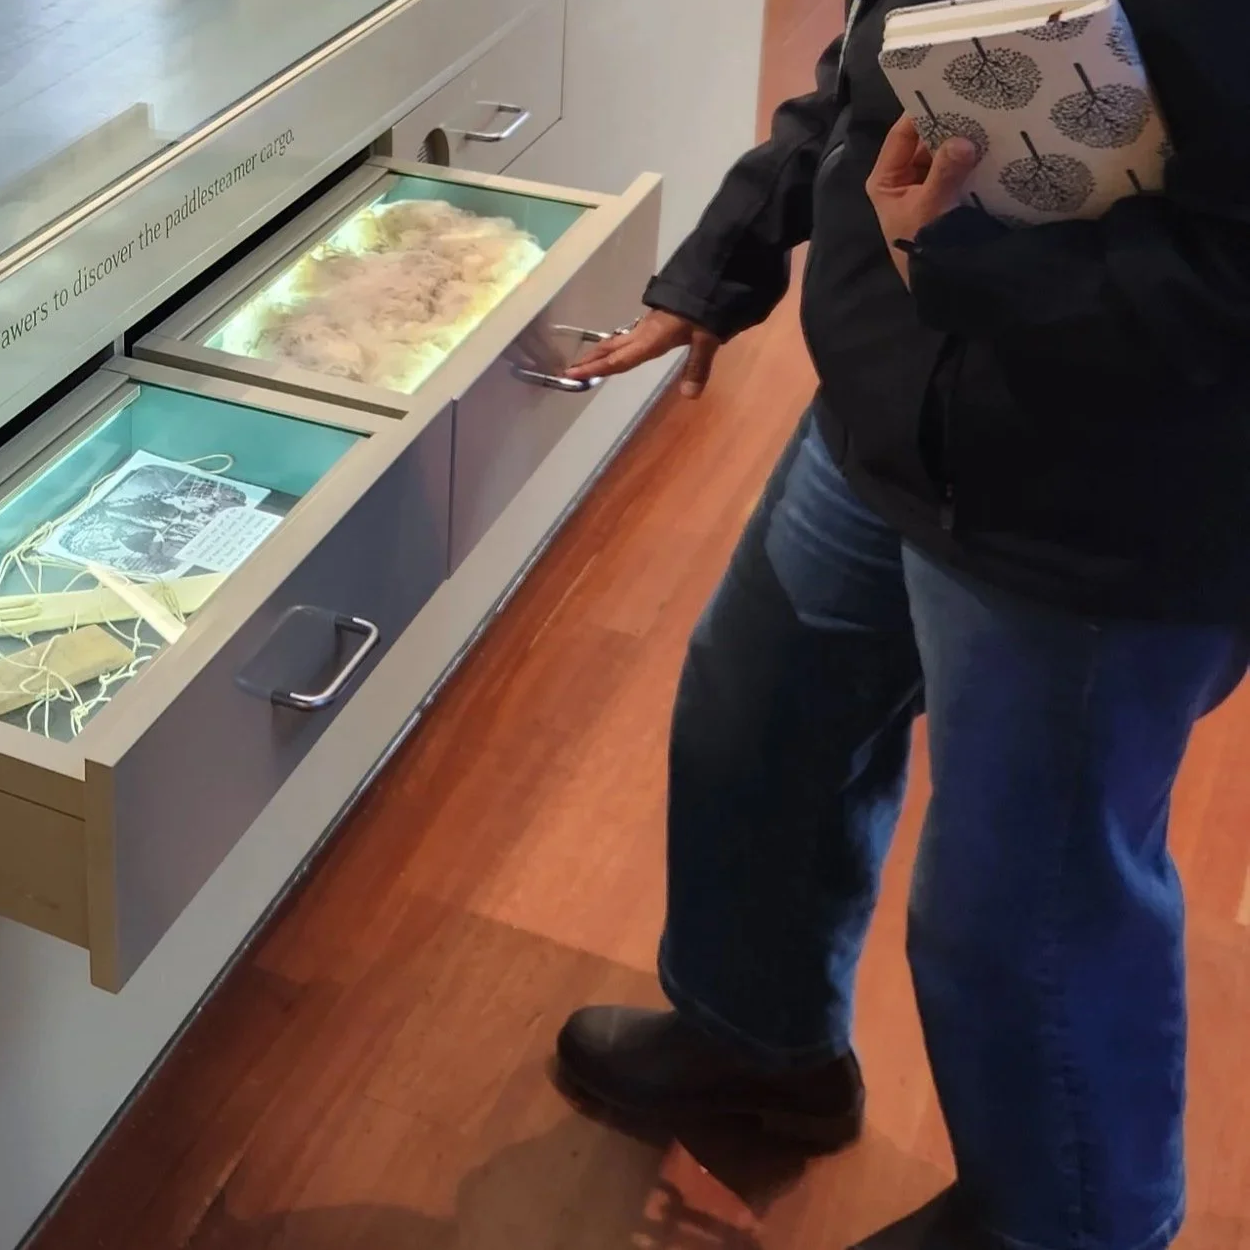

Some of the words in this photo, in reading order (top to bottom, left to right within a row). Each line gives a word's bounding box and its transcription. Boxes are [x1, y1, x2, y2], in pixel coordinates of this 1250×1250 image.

[53, 286, 69, 312] to
[73, 241, 135, 298] discover
[138, 221, 162, 251] the
[165, 151, 258, 240] paddlesteamer
[260, 125, 296, 164] cargo.
